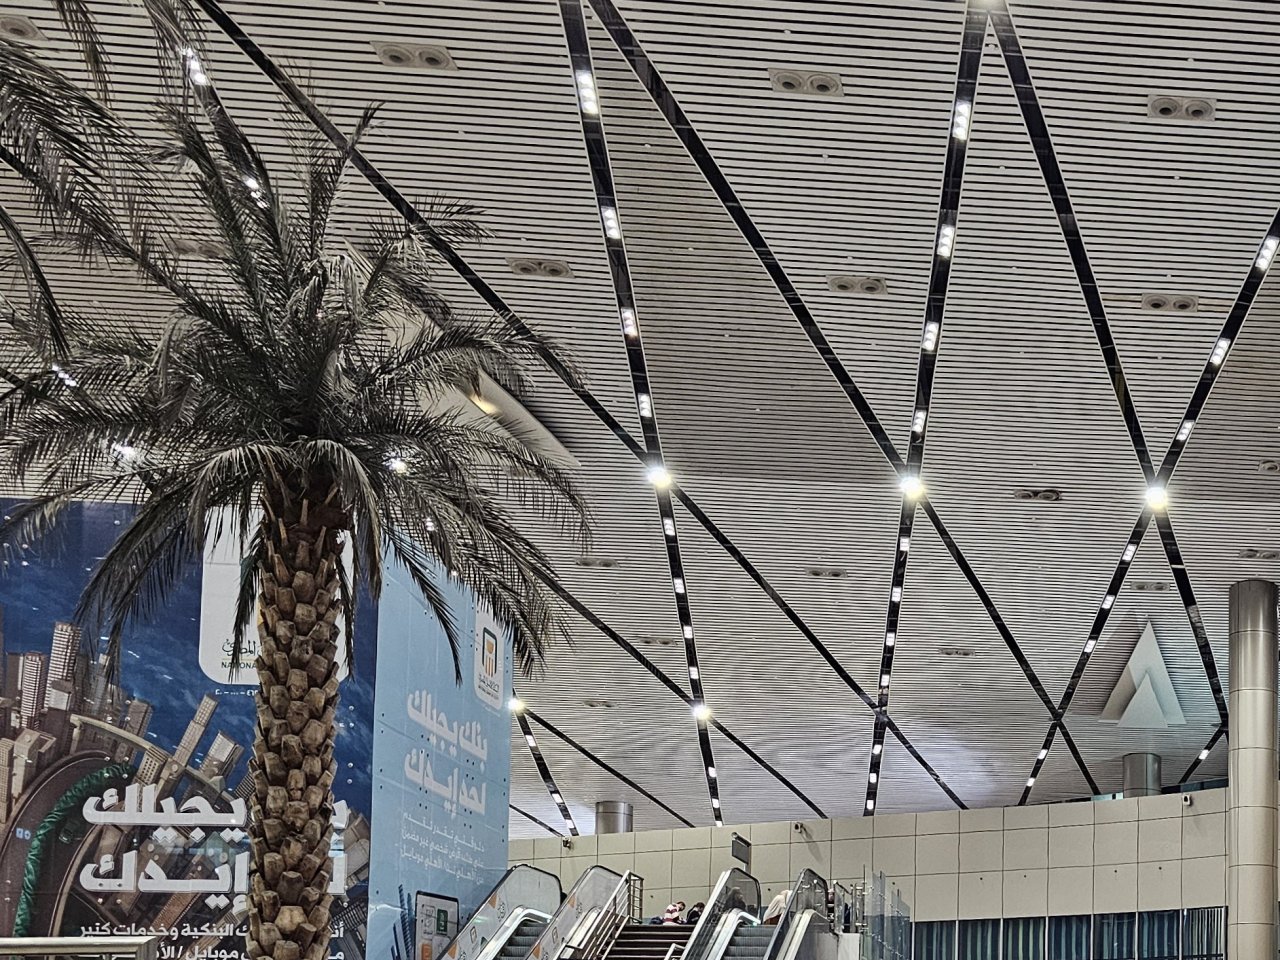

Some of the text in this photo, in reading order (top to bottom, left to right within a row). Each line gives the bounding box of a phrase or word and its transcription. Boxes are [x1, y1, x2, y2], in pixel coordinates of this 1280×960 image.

[407, 689, 488, 774] بنك يجيلك
[404, 748, 459, 820] إيدك
[459, 779, 486, 816] لحد
[83, 783, 248, 842] يجيلك
[114, 923, 179, 941] وخدمات
[181, 923, 234, 940] البنكية
